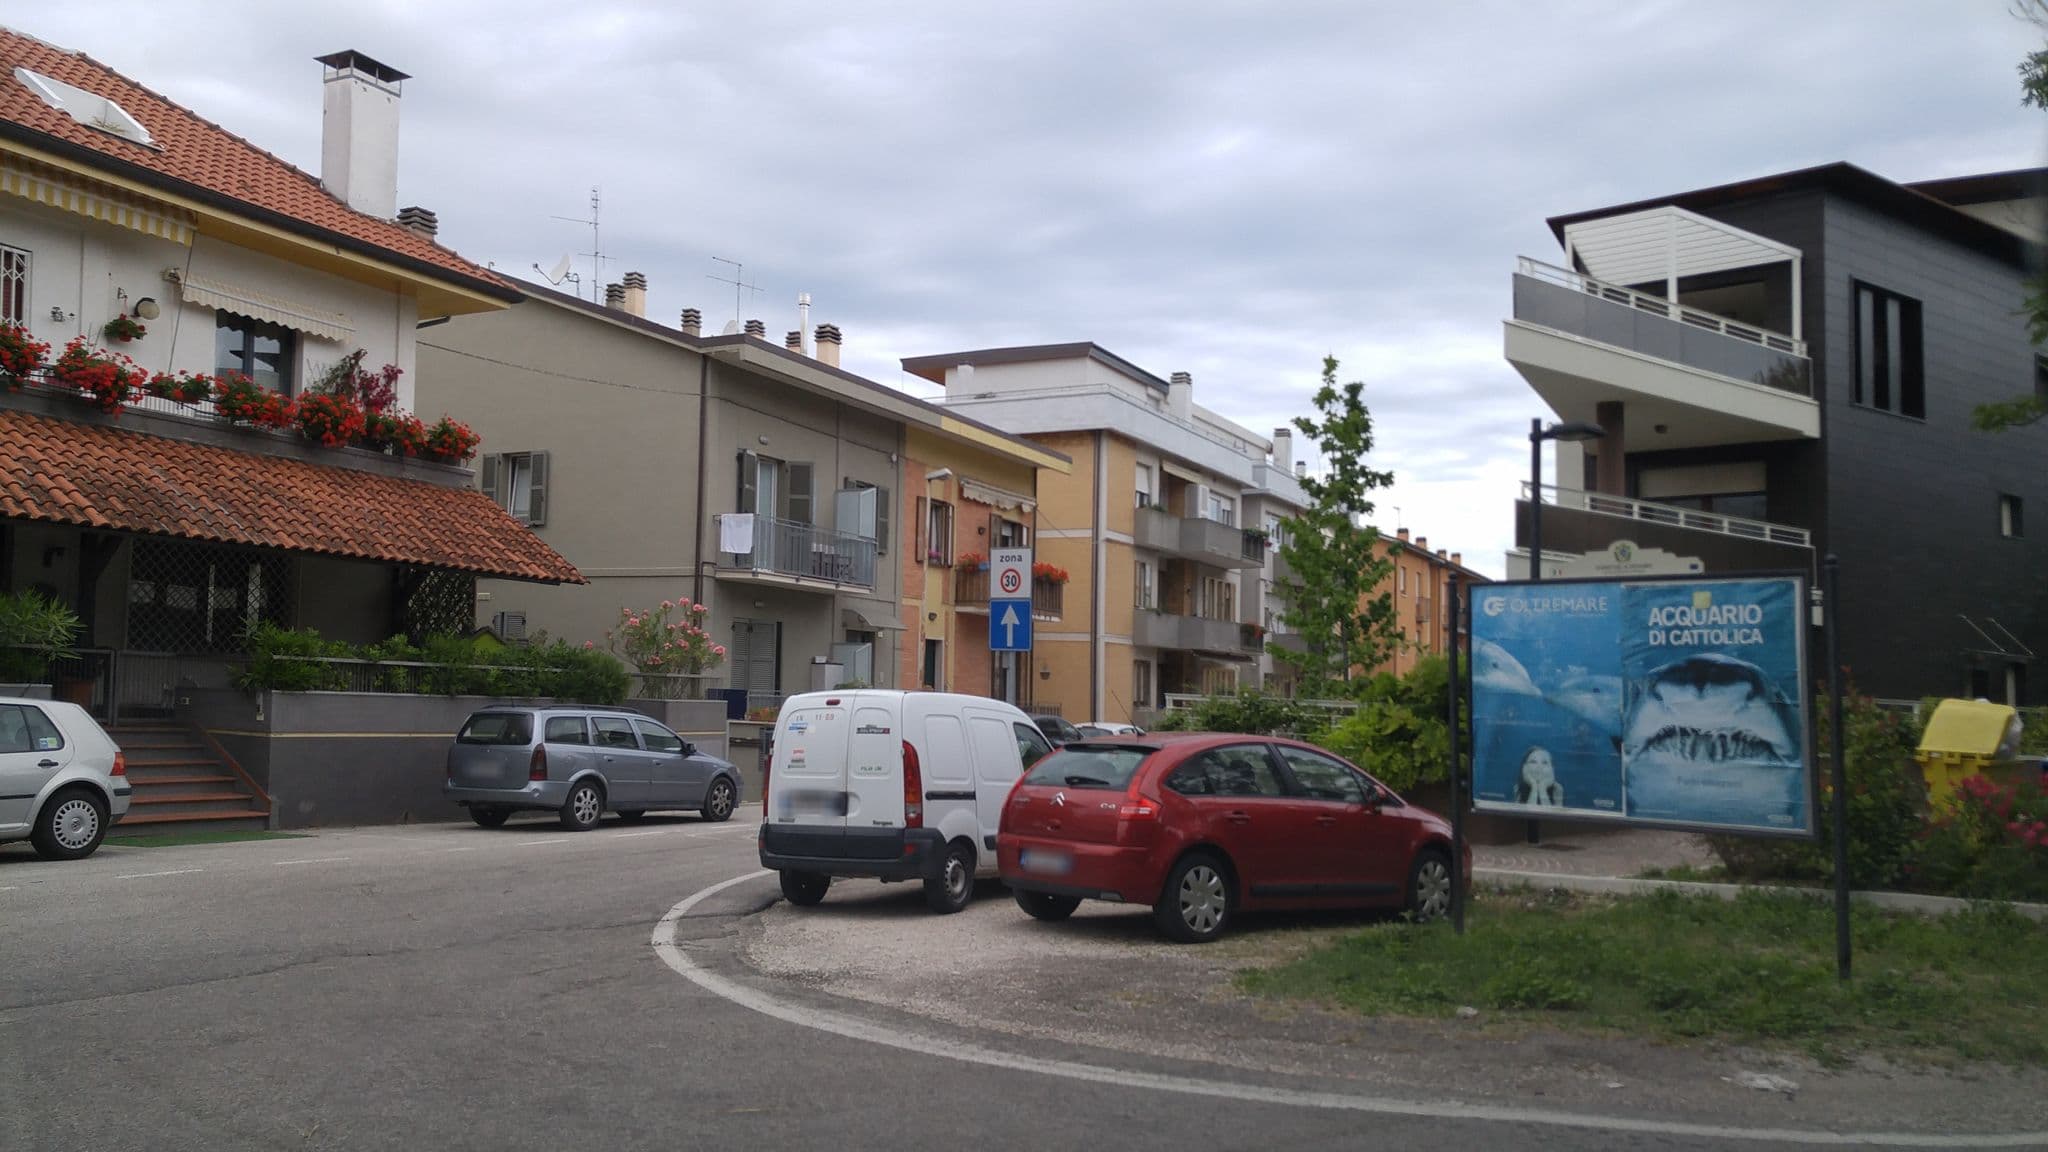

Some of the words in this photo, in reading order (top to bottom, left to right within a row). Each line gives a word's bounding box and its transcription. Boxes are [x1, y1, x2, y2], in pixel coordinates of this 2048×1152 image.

[1000, 554, 1023, 563] zona
[1005, 575, 1017, 587] 30
[1648, 604, 1763, 626] ACQUARIO
[1648, 630, 1666, 646] DI
[1669, 628, 1764, 646] CATTOLICA
